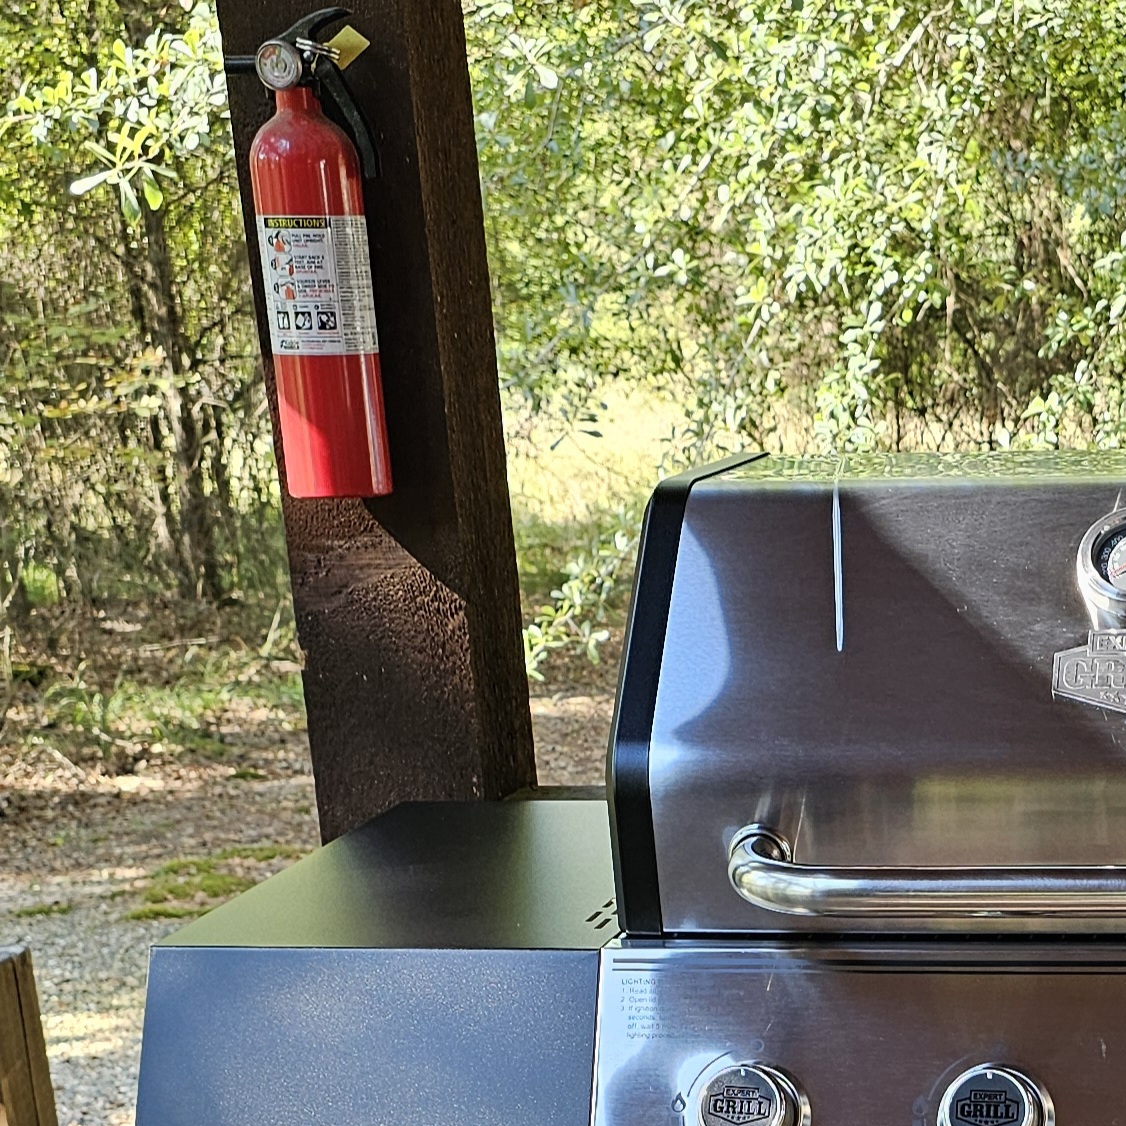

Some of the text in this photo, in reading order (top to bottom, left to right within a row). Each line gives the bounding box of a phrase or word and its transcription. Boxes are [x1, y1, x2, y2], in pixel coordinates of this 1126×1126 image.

[267, 219, 325, 228] INSTRUCTIONS
[726, 1088, 756, 1096] EXPERT
[973, 1092, 1003, 1100] EXPERT
[713, 1099, 767, 1115] GRILL
[959, 1103, 1015, 1119] GRILL
